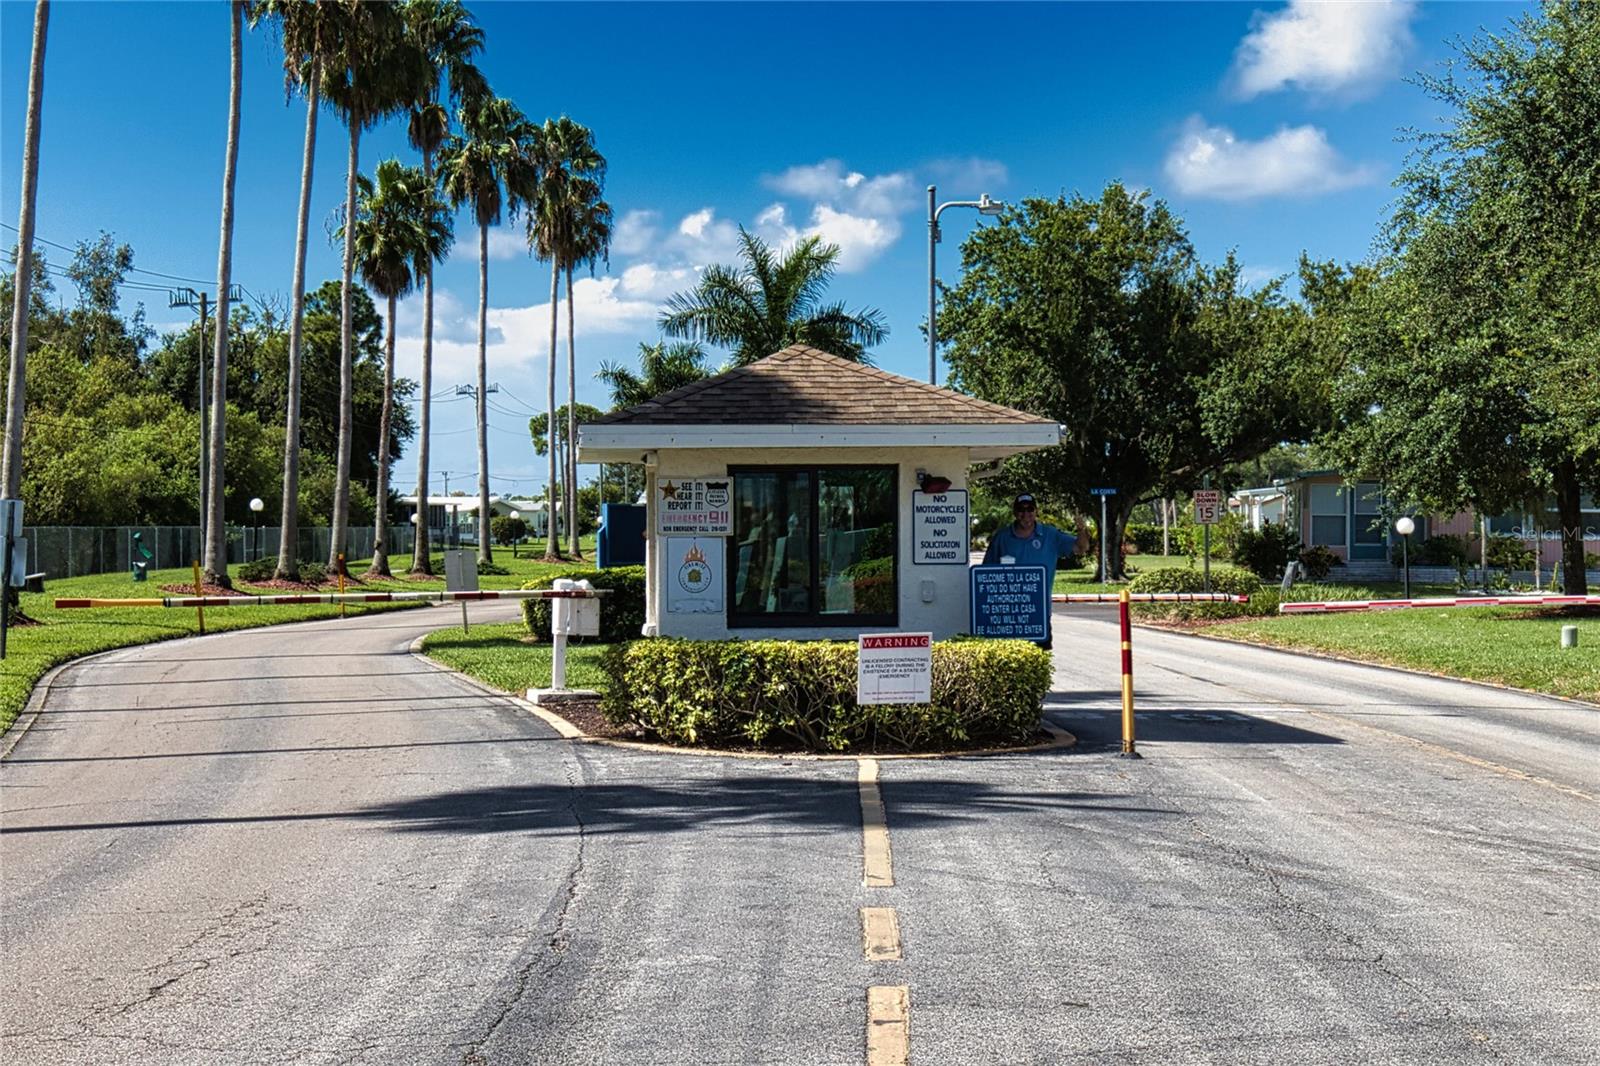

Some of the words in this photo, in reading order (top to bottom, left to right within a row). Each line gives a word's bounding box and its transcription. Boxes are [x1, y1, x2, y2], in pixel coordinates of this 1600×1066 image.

[682, 482, 692, 491] SEE
[695, 482, 703, 491] IT!
[677, 492, 692, 500] HEAR
[695, 492, 703, 500] IT!
[668, 502, 692, 510] REPORT
[695, 502, 703, 510] IT!
[709, 511, 728, 524] 911
[1199, 508, 1214, 518] 15
[977, 573, 1005, 582] WELCOME
[1007, 573, 1014, 582] TO
[1016, 573, 1023, 582] LA
[1025, 573, 1040, 582] CASA
[979, 584, 984, 592] IF
[986, 584, 998, 592] YOU
[999, 584, 1008, 592] DO
[1009, 584, 1021, 592] NOT
[1022, 584, 1038, 592] HAVE
[987, 594, 1031, 603] AUTHORIZATION
[982, 605, 990, 614] TO
[992, 604, 1010, 613] ENTER
[1011, 604, 1019, 613] LA
[1021, 604, 1036, 613] CASA
[990, 615, 1001, 624] YOU
[1003, 615, 1016, 624] WILL
[1018, 615, 1029, 624] NOT
[977, 626, 984, 634] BE
[986, 625, 1013, 634] ALLOWED
[1015, 625, 1023, 634] TO
[1024, 625, 1043, 633] ENTER
[864, 637, 928, 647] WARNING
